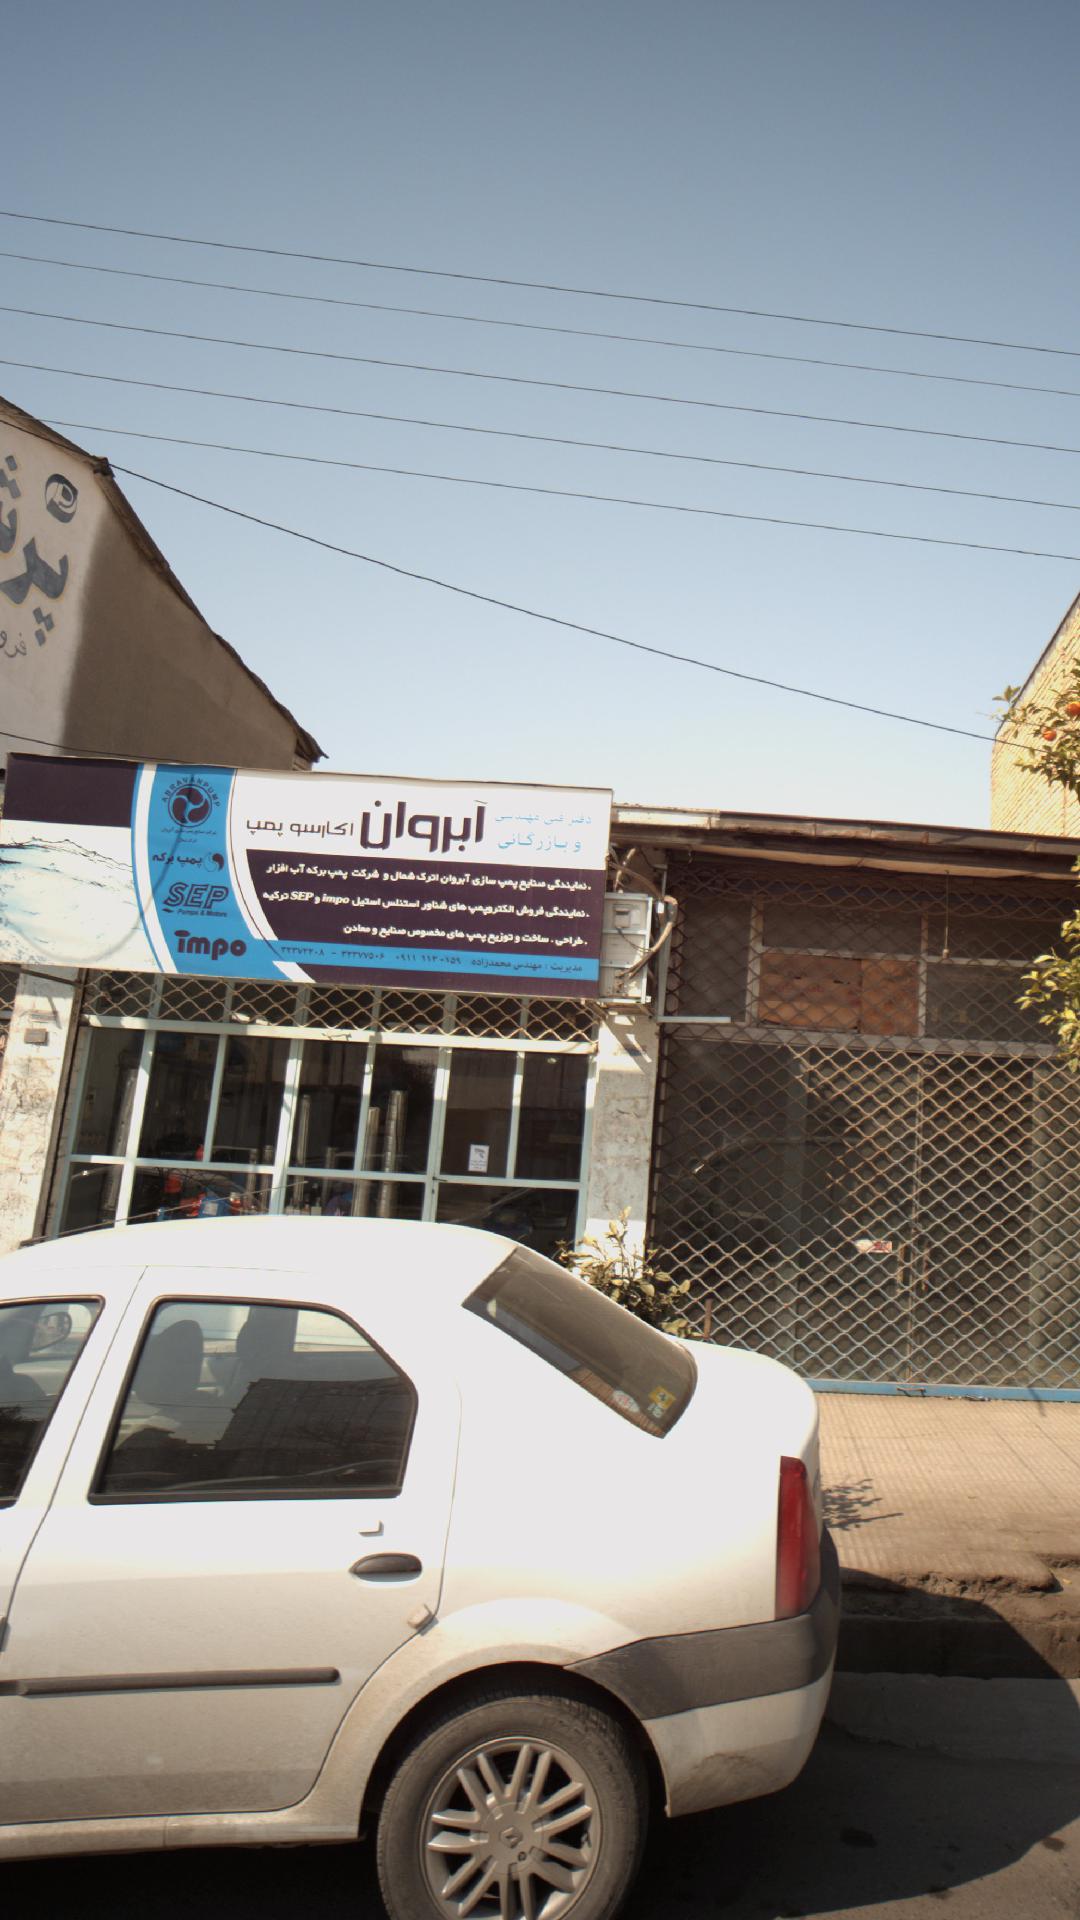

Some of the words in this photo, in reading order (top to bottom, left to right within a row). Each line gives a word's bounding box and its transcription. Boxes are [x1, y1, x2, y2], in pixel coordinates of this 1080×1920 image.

[246, 820, 283, 837] پمپ
[498, 832, 568, 853] بازرگانی
[177, 856, 202, 868] پمپ
[266, 863, 289, 874] افزار
[290, 864, 305, 874] آب
[306, 866, 326, 877] برکه
[352, 869, 380, 879] شرکت
[328, 869, 348, 880] پمپ
[390, 871, 416, 882] شمال
[440, 874, 470, 885] آبروان
[472, 875, 496, 886] سازی
[498, 879, 518, 890] پمپ
[519, 878, 546, 891] صنایع
[163, 881, 229, 909] SEP
[263, 890, 289, 901] ترکیه
[290, 891, 314, 901] SEP
[322, 894, 349, 905] impo
[352, 897, 380, 906] استیل
[421, 900, 447, 911] شناور
[449, 902, 466, 912] های
[516, 905, 545, 917] فروش
[343, 924, 370, 934] معادن
[379, 926, 406, 938] صنایع
[447, 929, 464, 939] های
[466, 933, 486, 943] پمپ
[488, 933, 513, 944] توزیع
[522, 933, 549, 943] ساخت
[174, 930, 247, 961] impo
